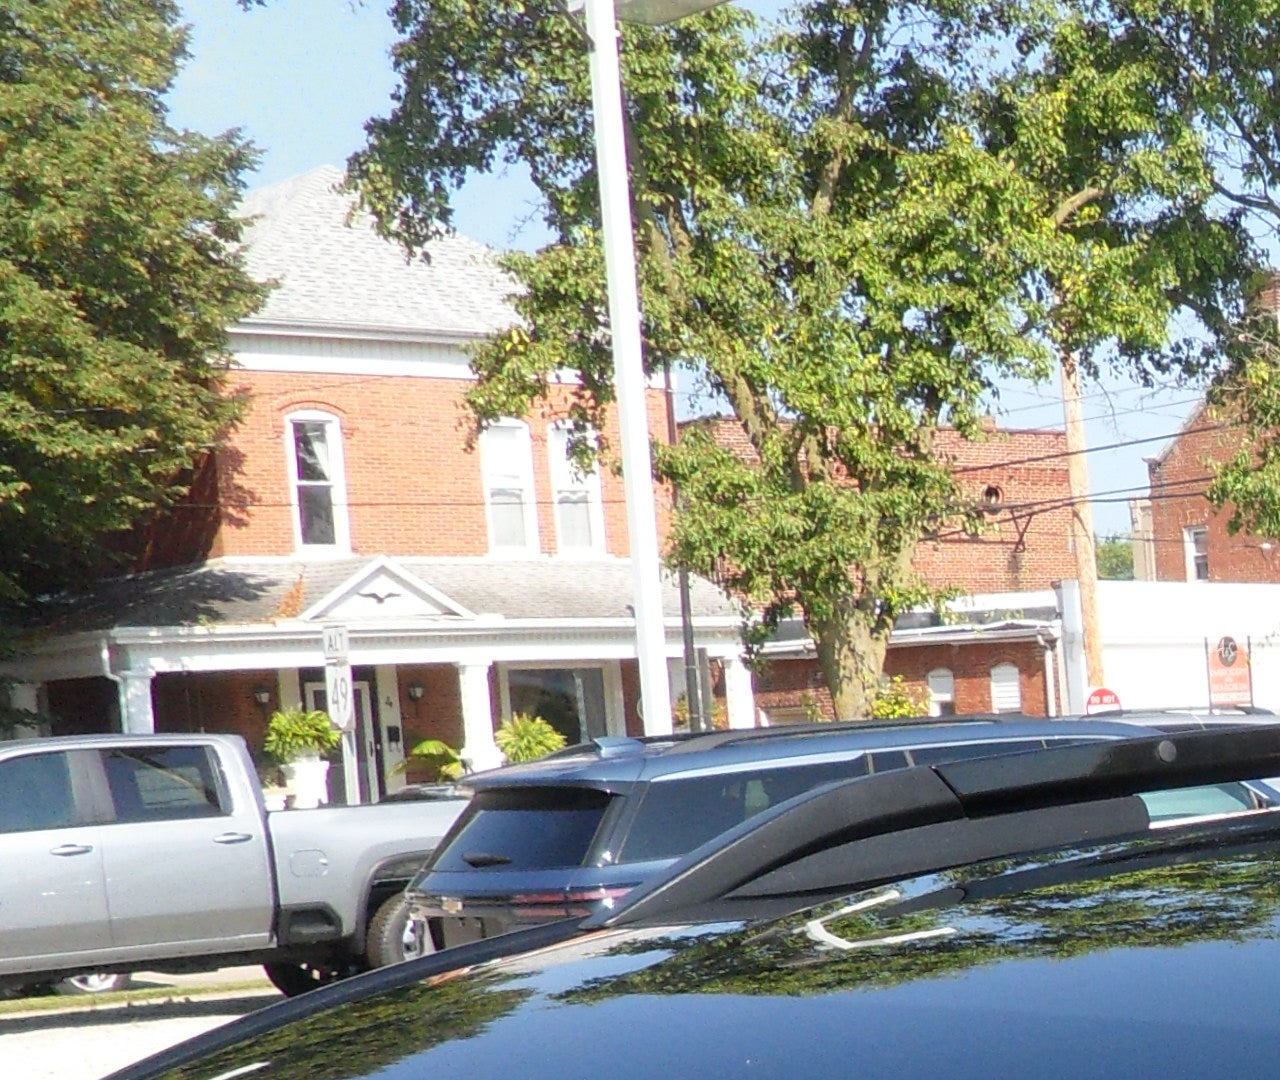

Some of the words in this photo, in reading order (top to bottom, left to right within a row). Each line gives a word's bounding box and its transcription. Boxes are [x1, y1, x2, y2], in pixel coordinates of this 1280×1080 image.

[331, 677, 349, 713] 49
[1090, 695, 1101, 704] DO
[1102, 694, 1116, 704] NOT
